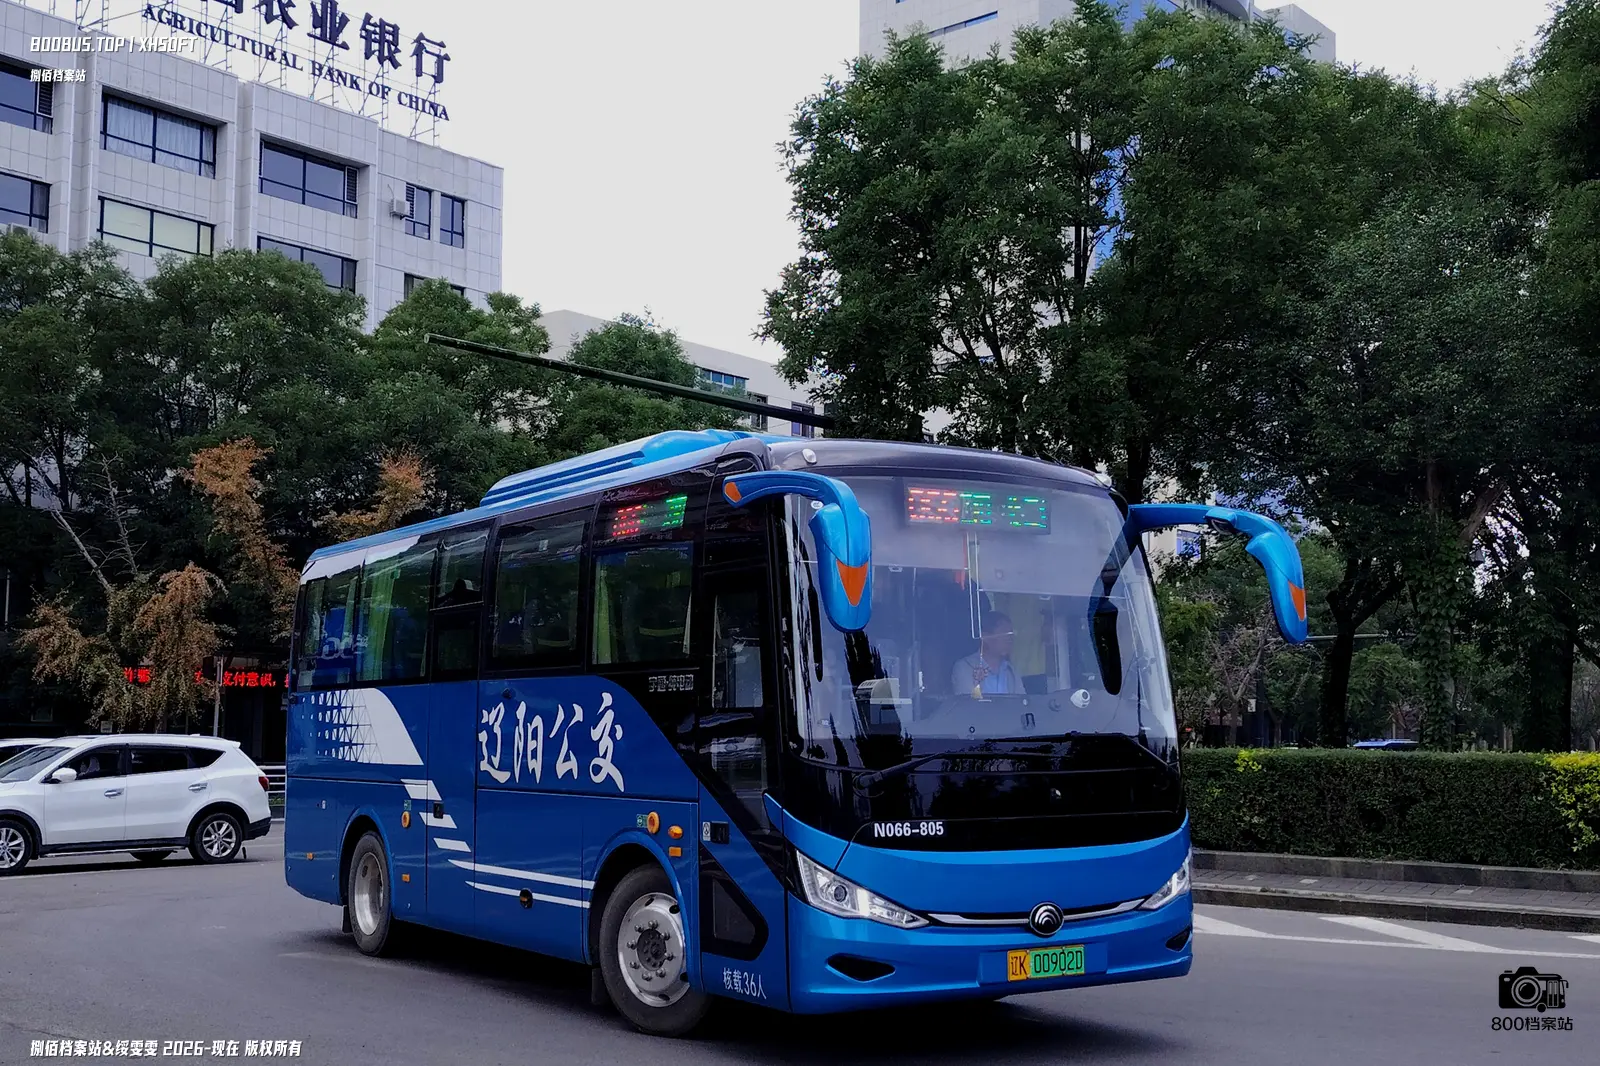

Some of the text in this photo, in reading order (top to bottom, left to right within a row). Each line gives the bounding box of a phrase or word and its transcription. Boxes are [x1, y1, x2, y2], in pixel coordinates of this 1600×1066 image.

[142, 4, 450, 121] AGRICULTURAL BANK OF CHINA
[213, 0, 451, 84] 农业银行
[478, 692, 625, 792] 辽阳公交
[873, 821, 945, 838] N066-805
[722, 967, 767, 1000] 核载36人
